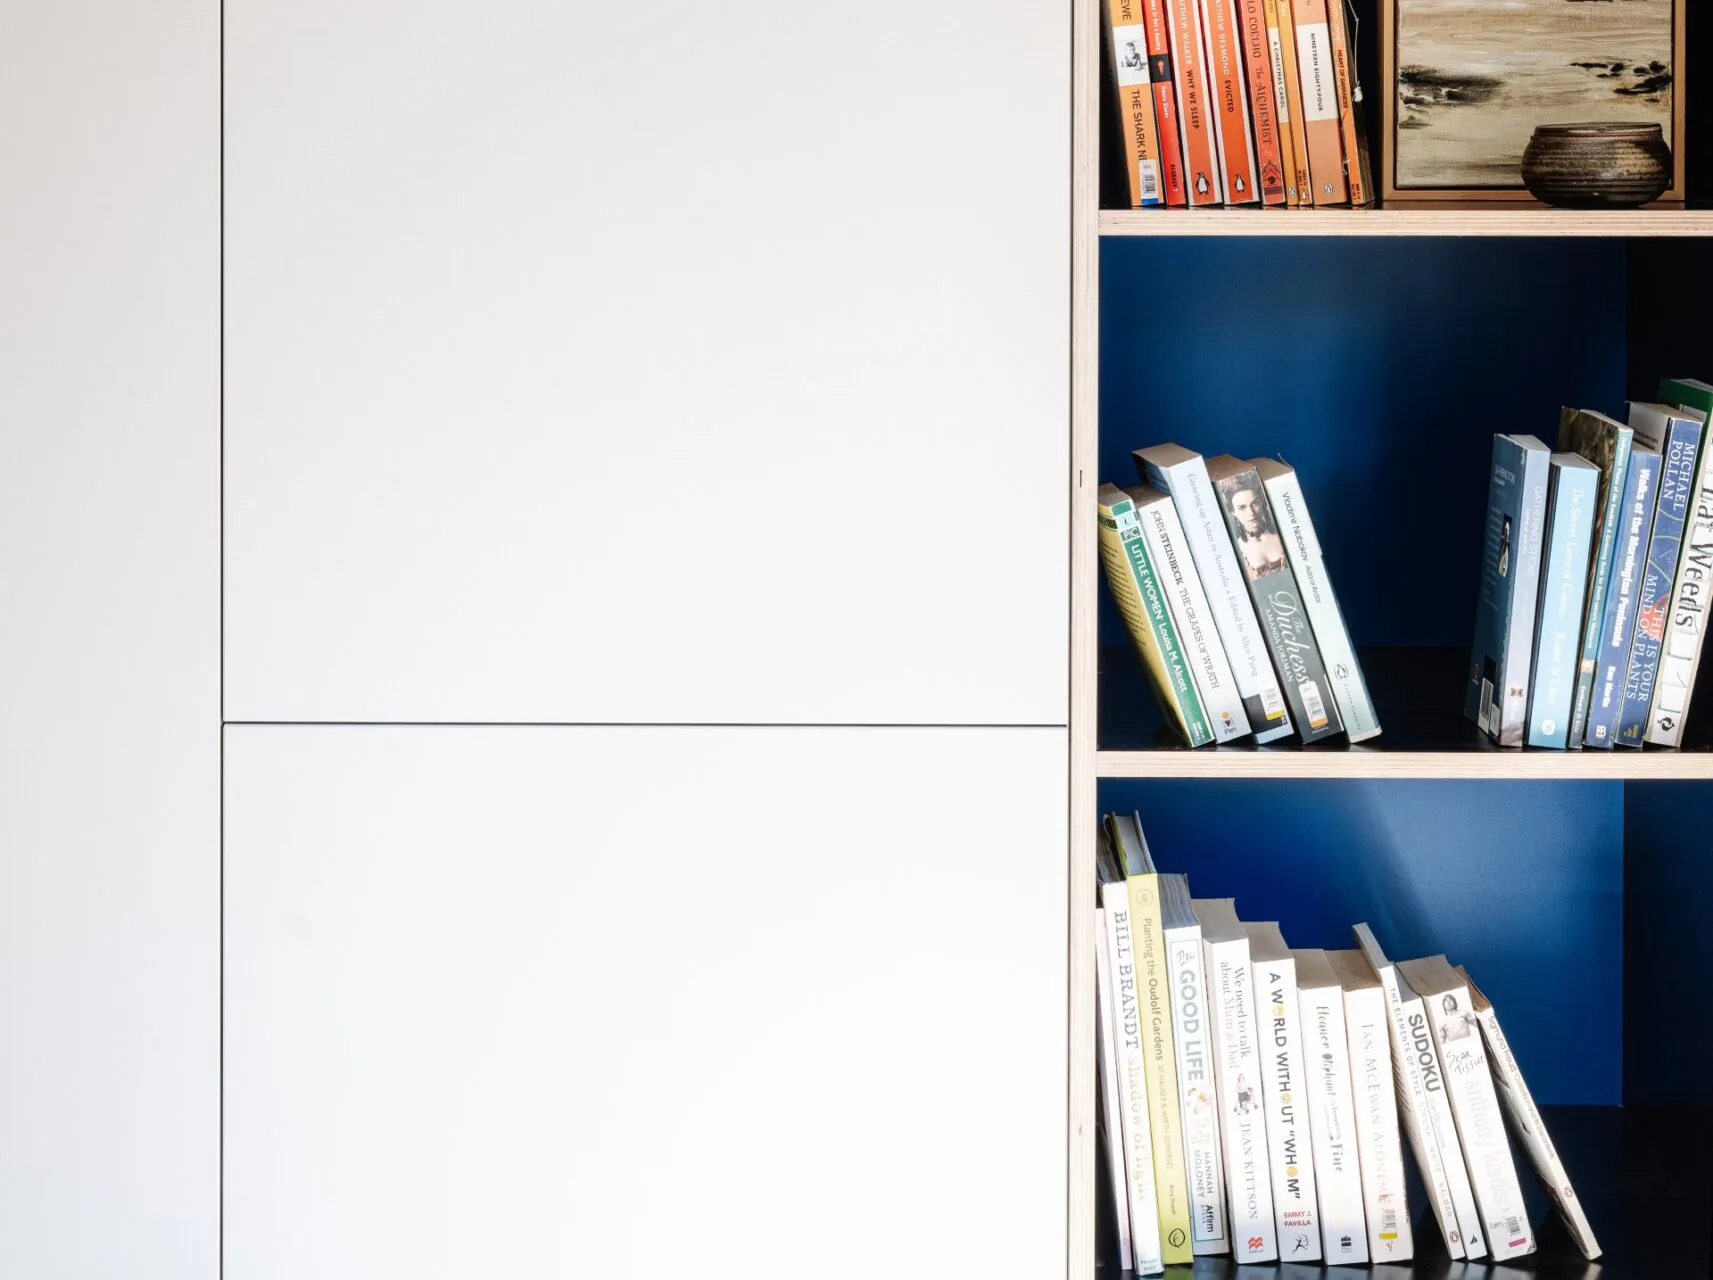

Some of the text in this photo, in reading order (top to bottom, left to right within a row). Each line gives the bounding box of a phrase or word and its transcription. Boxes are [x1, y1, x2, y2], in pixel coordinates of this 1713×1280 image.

[1182, 31, 1192, 64] WALKER
[1248, 16, 1261, 58] COELHO
[1310, 33, 1318, 65] NINETEEN
[1185, 69, 1195, 88] WHY
[1218, 33, 1229, 74] DESMOND
[1224, 79, 1234, 112] EVICTED
[1254, 67, 1263, 79] The
[1273, 47, 1283, 85] CHRISTMAS
[1338, 67, 1344, 75] OF
[1130, 89, 1141, 109] THE
[1188, 91, 1196, 104] WE
[1254, 80, 1271, 145] ALCHEMIST
[1339, 76, 1348, 108] DARKNESS
[1132, 111, 1145, 146] SHARK
[1190, 106, 1199, 129] SLEEP
[1662, 440, 1683, 499] POLLAN
[1672, 442, 1694, 511] MICHAEL
[1280, 491, 1298, 525] Vladimir
[1291, 525, 1310, 562] Nabokov
[1303, 564, 1314, 579] Ada
[1310, 584, 1322, 604] Ardor
[1611, 468, 1650, 647] Walks of the Mornington Peninsula
[1185, 473, 1260, 677] Growing up Asian in Australia Edited by Alice Pung
[1673, 539, 1713, 629] Weeds
[1129, 543, 1189, 692] LITTLE WOMEN Louisa M. Alcott
[1150, 509, 1219, 689] JOHN STEINBECK THE GRAPES OF WRATH
[1262, 607, 1295, 682] AMANDA FOREMAN
[1268, 590, 1312, 685] Duchess
[1290, 614, 1306, 635] The
[1625, 574, 1658, 700] MIND ON PLANTS
[1636, 606, 1664, 702] THIS IS YOUR
[1111, 910, 1131, 958] BILL
[1140, 917, 1156, 958] Planting
[1145, 959, 1157, 976] the
[1218, 960, 1233, 995] about
[1268, 971, 1281, 983] A
[1117, 963, 1140, 1049] BRANDT
[1147, 978, 1162, 1015] Oudolf
[1177, 969, 1200, 1033] GOOD
[1222, 997, 1236, 1029] Mum
[1232, 966, 1251, 1058] We need to talk
[1389, 986, 1400, 1005] THE
[1151, 1017, 1166, 1060] Gardens
[1360, 1022, 1376, 1050] IAN
[1394, 1007, 1411, 1053] ELEMENTS
[1485, 1014, 1507, 1049] Sigmund
[1501, 1048, 1518, 1072] Freud
[1184, 1040, 1204, 1080] LIFE
[1226, 1043, 1240, 1068] Dad
[1405, 1054, 1415, 1066] OF
[1407, 1012, 1440, 1093] SUDOKU
[1126, 1056, 1147, 1129] shadow
[1315, 1005, 1333, 1049] Eleanor
[1330, 1143, 1345, 1173] Fine
[1409, 1069, 1422, 1095] STYLE
[1133, 1132, 1149, 1152] of
[1192, 1149, 1205, 1198] MOLONEY
[1201, 1152, 1214, 1194] HANNAH
[1238, 1121, 1259, 1219] JEAN KITTSON
[1204, 1204, 1215, 1232] Affirm
[1438, 1182, 1452, 1217] KALMAN
